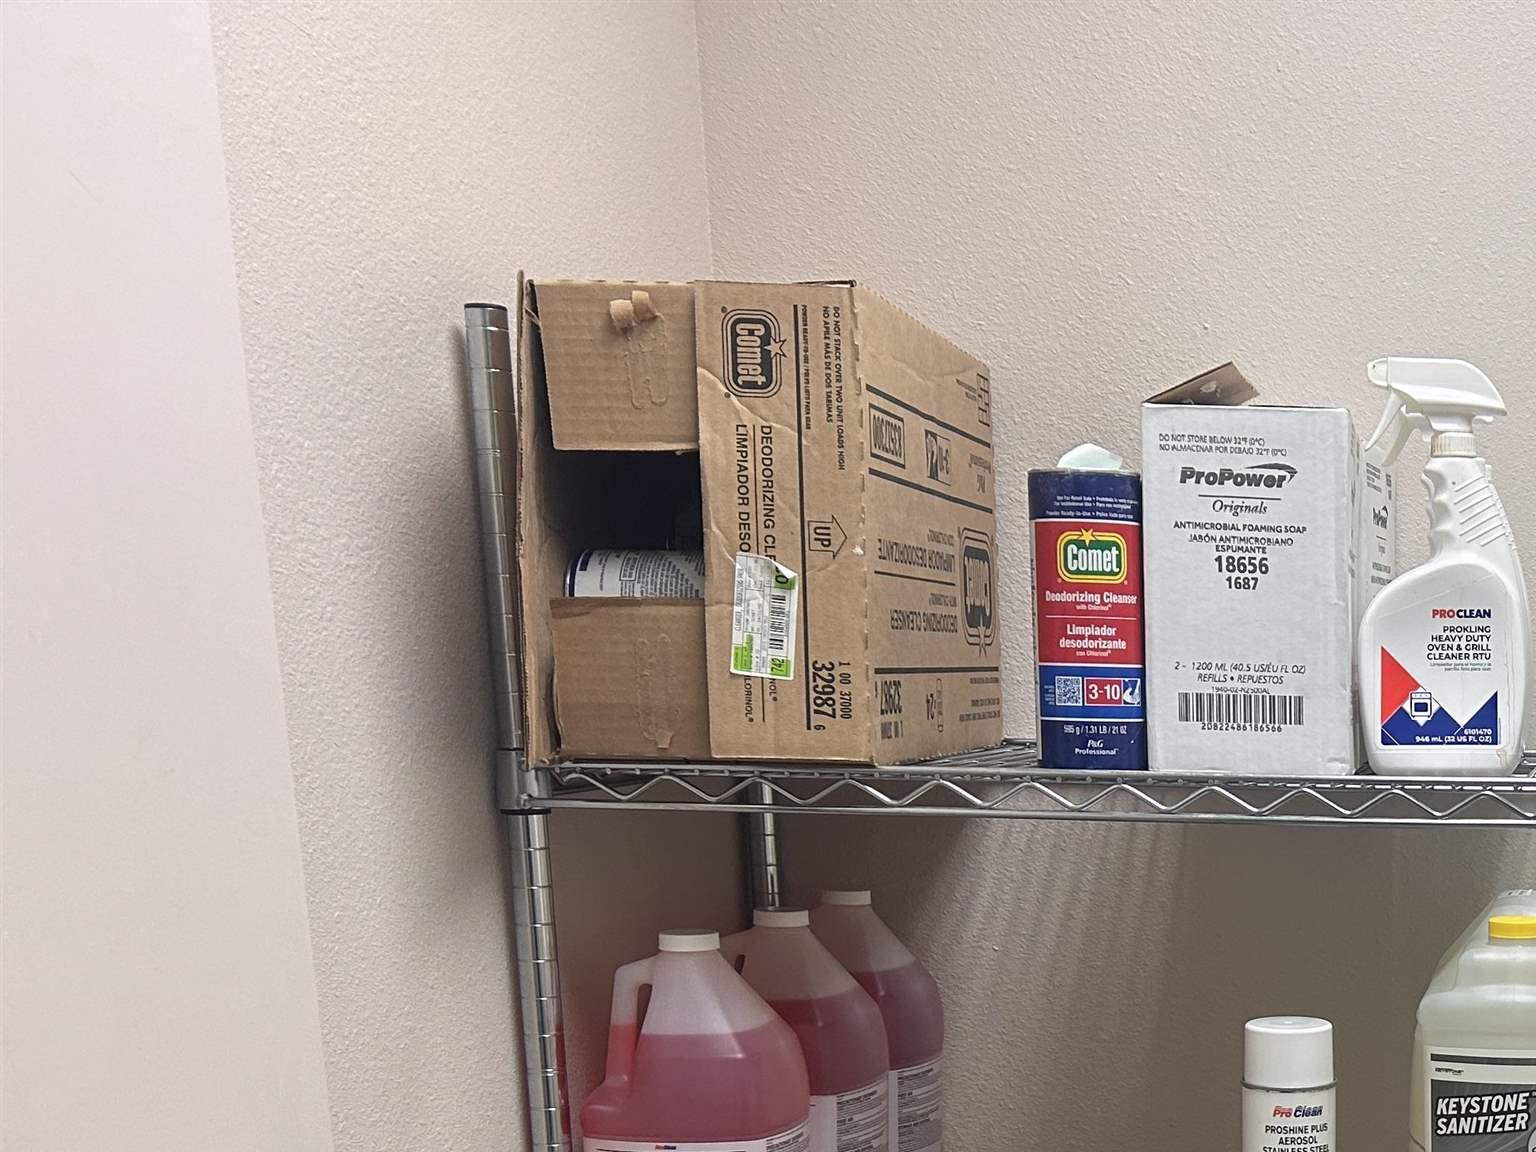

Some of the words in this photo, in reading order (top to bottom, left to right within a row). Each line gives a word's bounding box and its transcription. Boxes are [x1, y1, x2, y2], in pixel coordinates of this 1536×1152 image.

[822, 306, 830, 318] NO
[833, 306, 841, 319] DO
[833, 320, 841, 336] NOT
[736, 323, 766, 385] Comet
[834, 338, 842, 361] STACK
[825, 362, 832, 372] DE
[834, 363, 842, 383] OVER
[836, 424, 844, 449] LOADS
[1171, 434, 1186, 442] NOT
[1186, 435, 1207, 444] STORE
[1209, 436, 1232, 444] BELOW
[1215, 446, 1228, 454] POR
[735, 424, 750, 506] LIMPIADOR
[761, 425, 776, 529] DEODORIZING
[1180, 466, 1287, 488] ProPower
[1212, 499, 1268, 517] Originals
[1173, 521, 1240, 532] ANTIMICROBIAL
[1242, 524, 1282, 534] FOAMING
[1284, 525, 1307, 534] SOAP
[813, 526, 832, 548] UP
[1188, 533, 1216, 543] JABÓN
[1218, 536, 1294, 546] ANTIMICROBIANO
[1216, 544, 1267, 554] ESPUMANTE
[1067, 544, 1120, 573] Comet
[1214, 555, 1269, 574] 18656
[1226, 576, 1258, 590] 1687
[1046, 590, 1100, 604] Deodorizing
[1104, 591, 1137, 604] Cleanser
[890, 608, 922, 630] CLEANSER
[1432, 608, 1492, 619] PROCLEAN
[1067, 624, 1117, 637] Limpiador
[1442, 625, 1491, 634] PROKLING
[1060, 637, 1126, 650] desodorizante
[1431, 634, 1463, 642] HEAVY
[1466, 634, 1492, 642] DUTY
[1427, 644, 1454, 652] OVEN
[1456, 644, 1462, 652] &
[1464, 644, 1492, 652] GRILL
[1427, 652, 1470, 660] CLEANER
[1472, 652, 1491, 660] RTU
[1174, 661, 1180, 670] 2
[1192, 662, 1212, 671] 1200
[1214, 663, 1228, 672] ML
[1230, 662, 1250, 672] (40.5
[1280, 664, 1289, 674] FL
[840, 673, 852, 684] 00
[1198, 674, 1228, 682] REFILLS
[1237, 674, 1284, 684] REPUESTOS
[812, 660, 836, 719] 32987
[1088, 684, 1120, 700] 3-10
[840, 690, 852, 720] 37000
[1444, 736, 1456, 744] (32
[1479, 736, 1492, 744] OZ)
[1436, 1092, 1530, 1116] KEYSTONE
[1273, 1106, 1292, 1117] Pro
[1294, 1105, 1323, 1118] Clean
[1265, 1125, 1309, 1134] PROSHINE
[1311, 1122, 1328, 1133] PLUS
[1436, 1112, 1530, 1135] SANITIZER
[1279, 1136, 1318, 1145] AEROSOL
